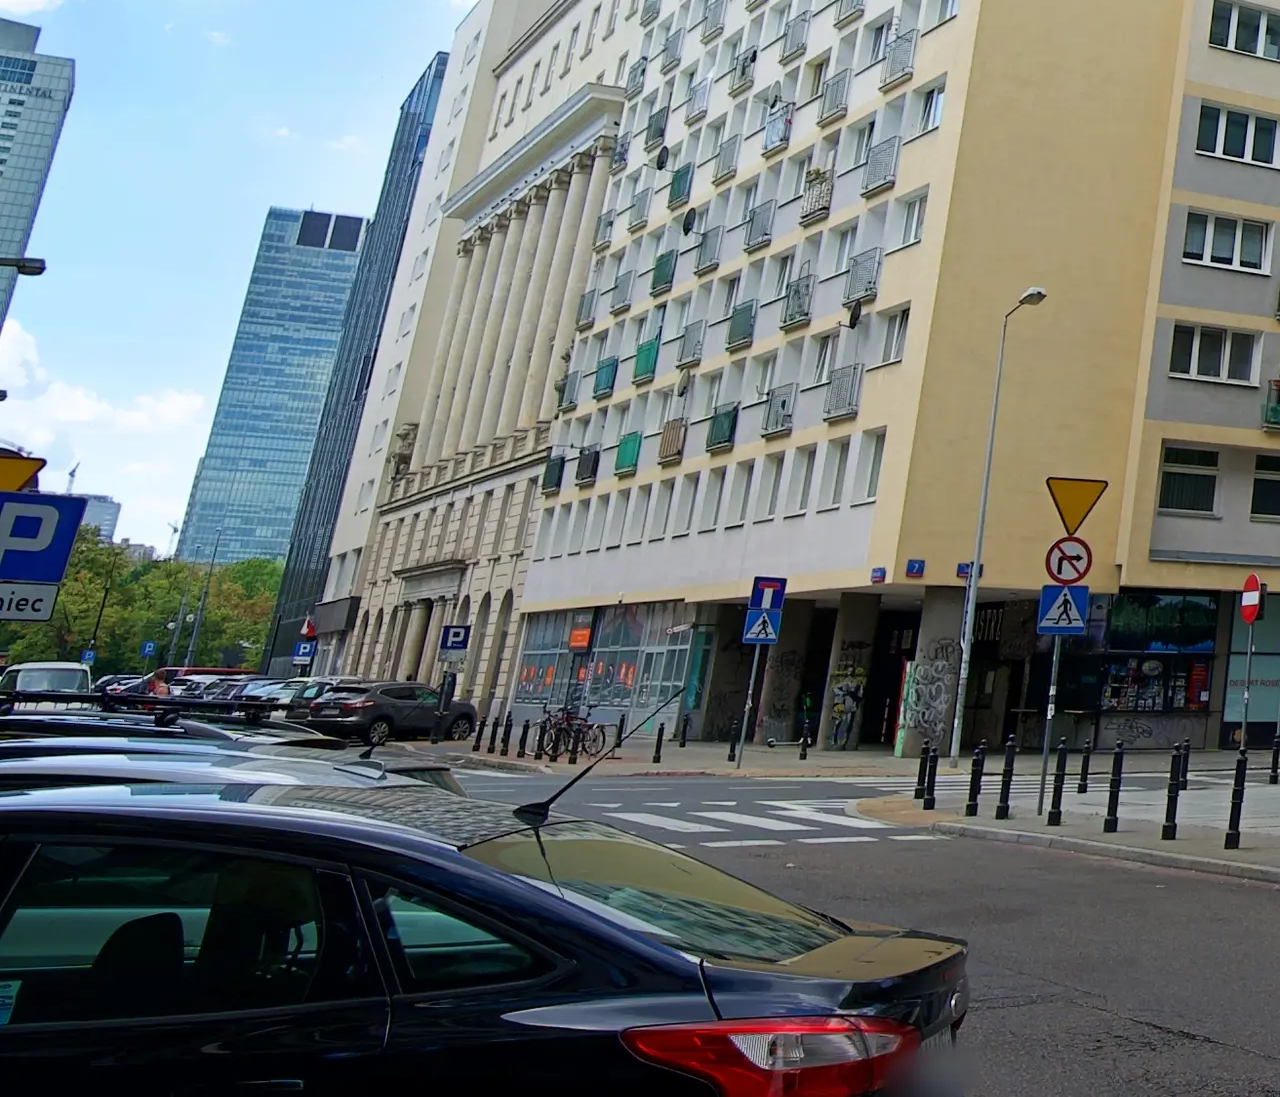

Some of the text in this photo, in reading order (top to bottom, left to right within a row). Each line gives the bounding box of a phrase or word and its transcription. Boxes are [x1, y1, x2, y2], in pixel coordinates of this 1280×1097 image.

[0, 502, 59, 566] P
[912, 563, 919, 573] 7
[447, 628, 465, 647] P
[144, 642, 154, 652] P
[300, 643, 310, 655] P
